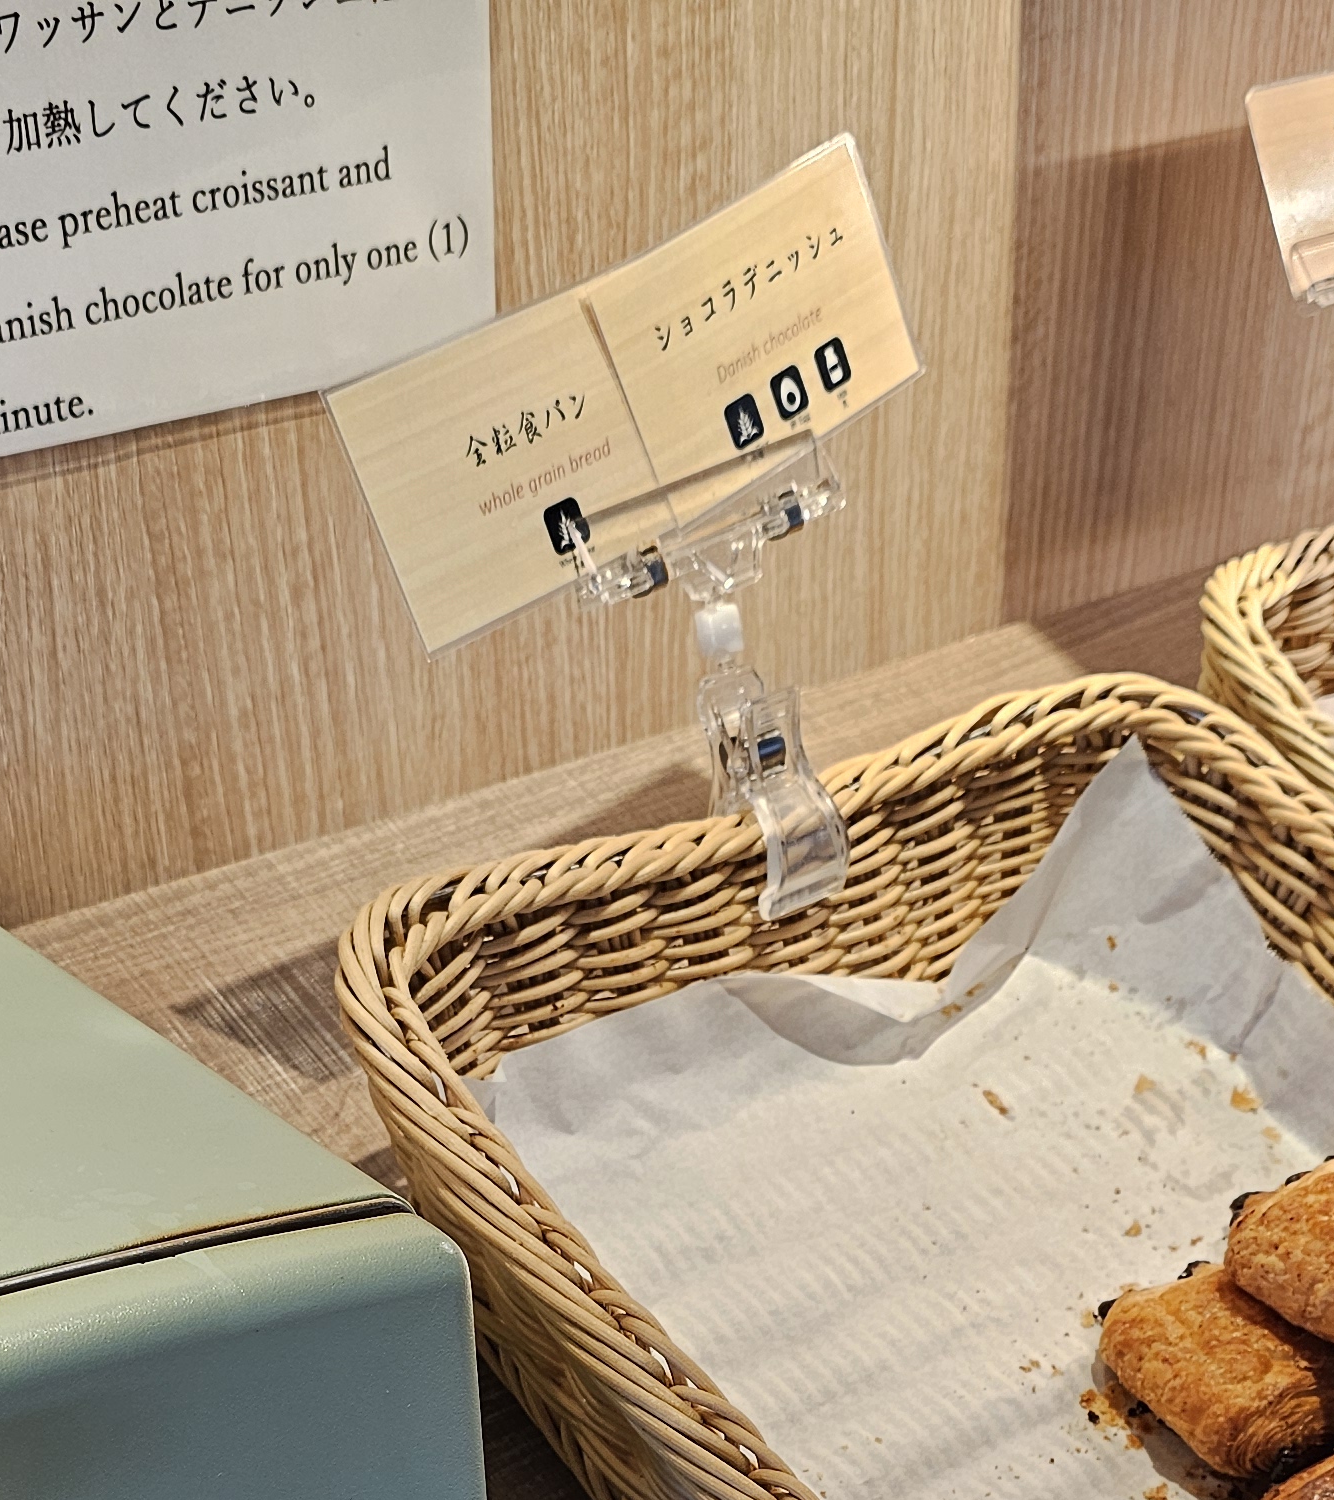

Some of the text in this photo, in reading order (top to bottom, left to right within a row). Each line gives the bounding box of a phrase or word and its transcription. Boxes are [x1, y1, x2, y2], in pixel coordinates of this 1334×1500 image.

[58, 192, 181, 248] preheat
[192, 165, 329, 214] croissant
[337, 145, 391, 189] and
[84, 273, 233, 328] chocolate
[240, 258, 285, 296] for
[295, 241, 357, 286] only
[367, 237, 418, 271] one
[428, 214, 470, 264] (1)
[654, 228, 843, 351] ショコラデニッシュ
[717, 307, 823, 384] Danish chocolate
[466, 392, 585, 467] 全粒食パン
[479, 437, 610, 516] whole grain bread
